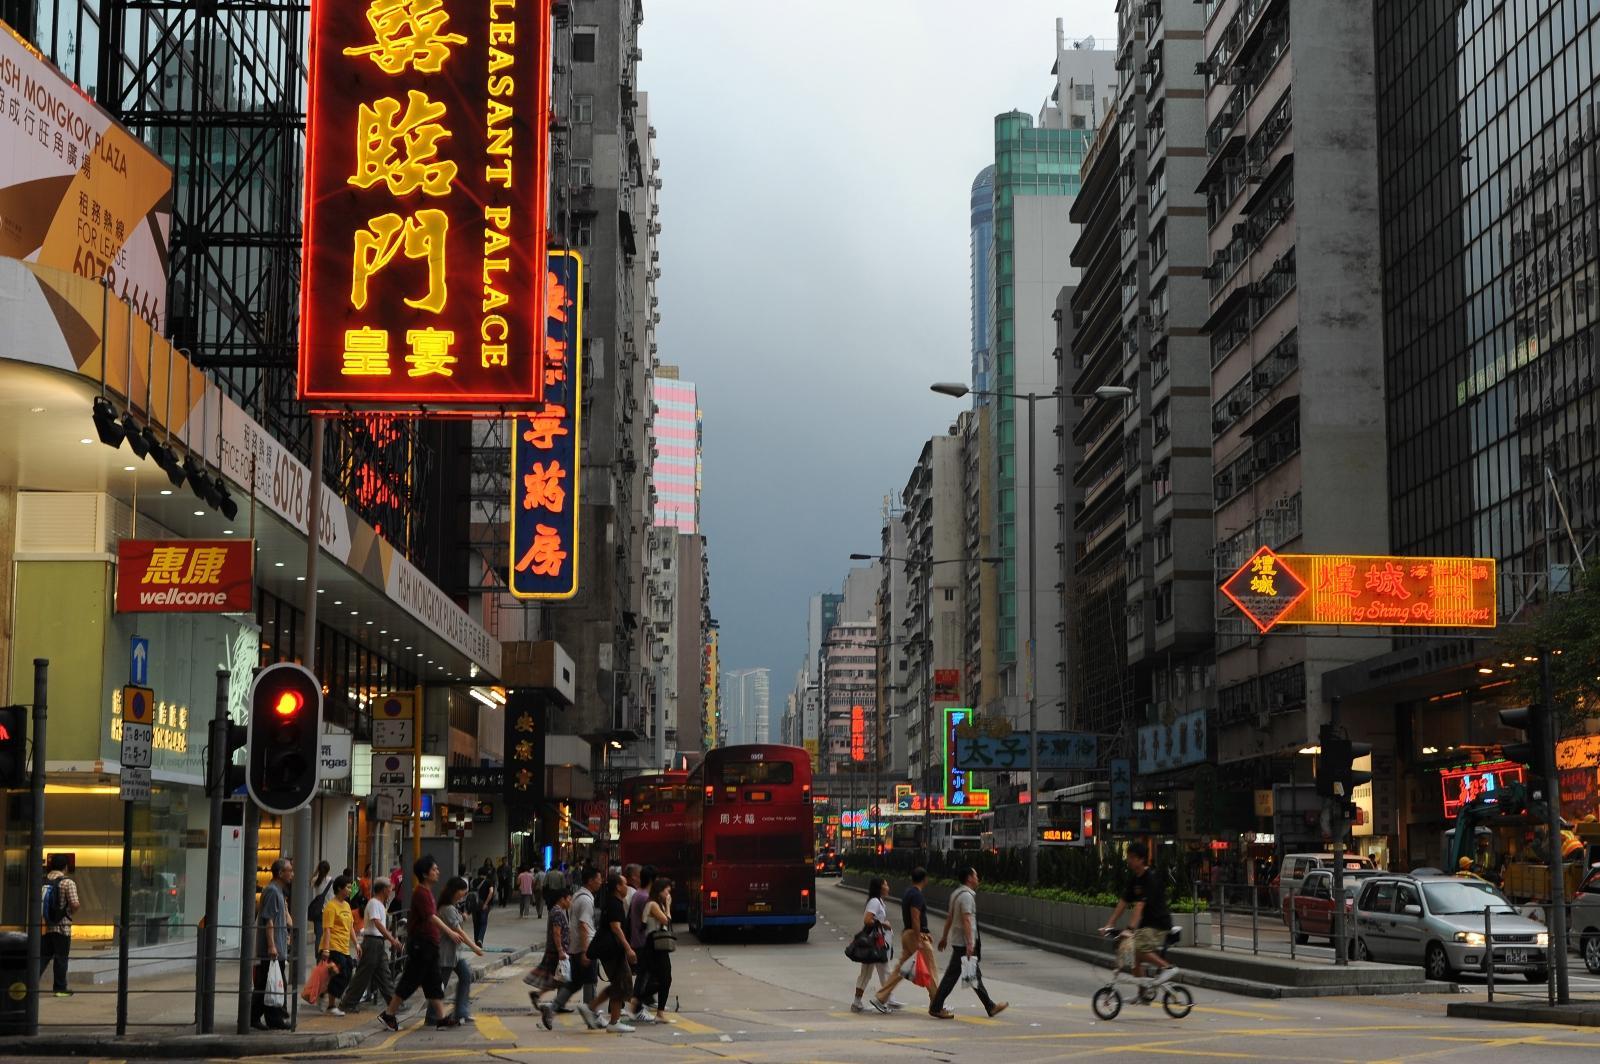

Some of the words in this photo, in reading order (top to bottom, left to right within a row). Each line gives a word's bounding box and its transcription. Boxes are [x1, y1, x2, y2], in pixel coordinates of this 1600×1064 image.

[24, 74, 91, 150] MONGKOK
[94, 133, 127, 179] PLAZA
[79, 190, 125, 242] 租務熱線
[77, 217, 97, 248] FOR
[100, 234, 127, 270] LEASE
[481, 205, 511, 368] PALACE
[341, 325, 458, 377] 皇宴
[216, 434, 239, 473] OFFICE
[240, 452, 254, 484] FOR
[255, 467, 271, 498] LEASE
[273, 449, 303, 524] 6078
[141, 547, 228, 584] 惠康
[140, 588, 227, 605] wellcome
[398, 564, 411, 606] HSH
[412, 575, 443, 633] MONGKOK
[443, 603, 459, 642] PLAZA
[1367, 600, 1409, 623] Shing
[1411, 602, 1489, 621] Restaurant
[134, 729, 150, 742] 8-10
[959, 738, 1026, 767] 太子
[398, 804, 409, 814] 12
[719, 813, 755, 824] 周大福
[1062, 830, 1072, 840] 112
